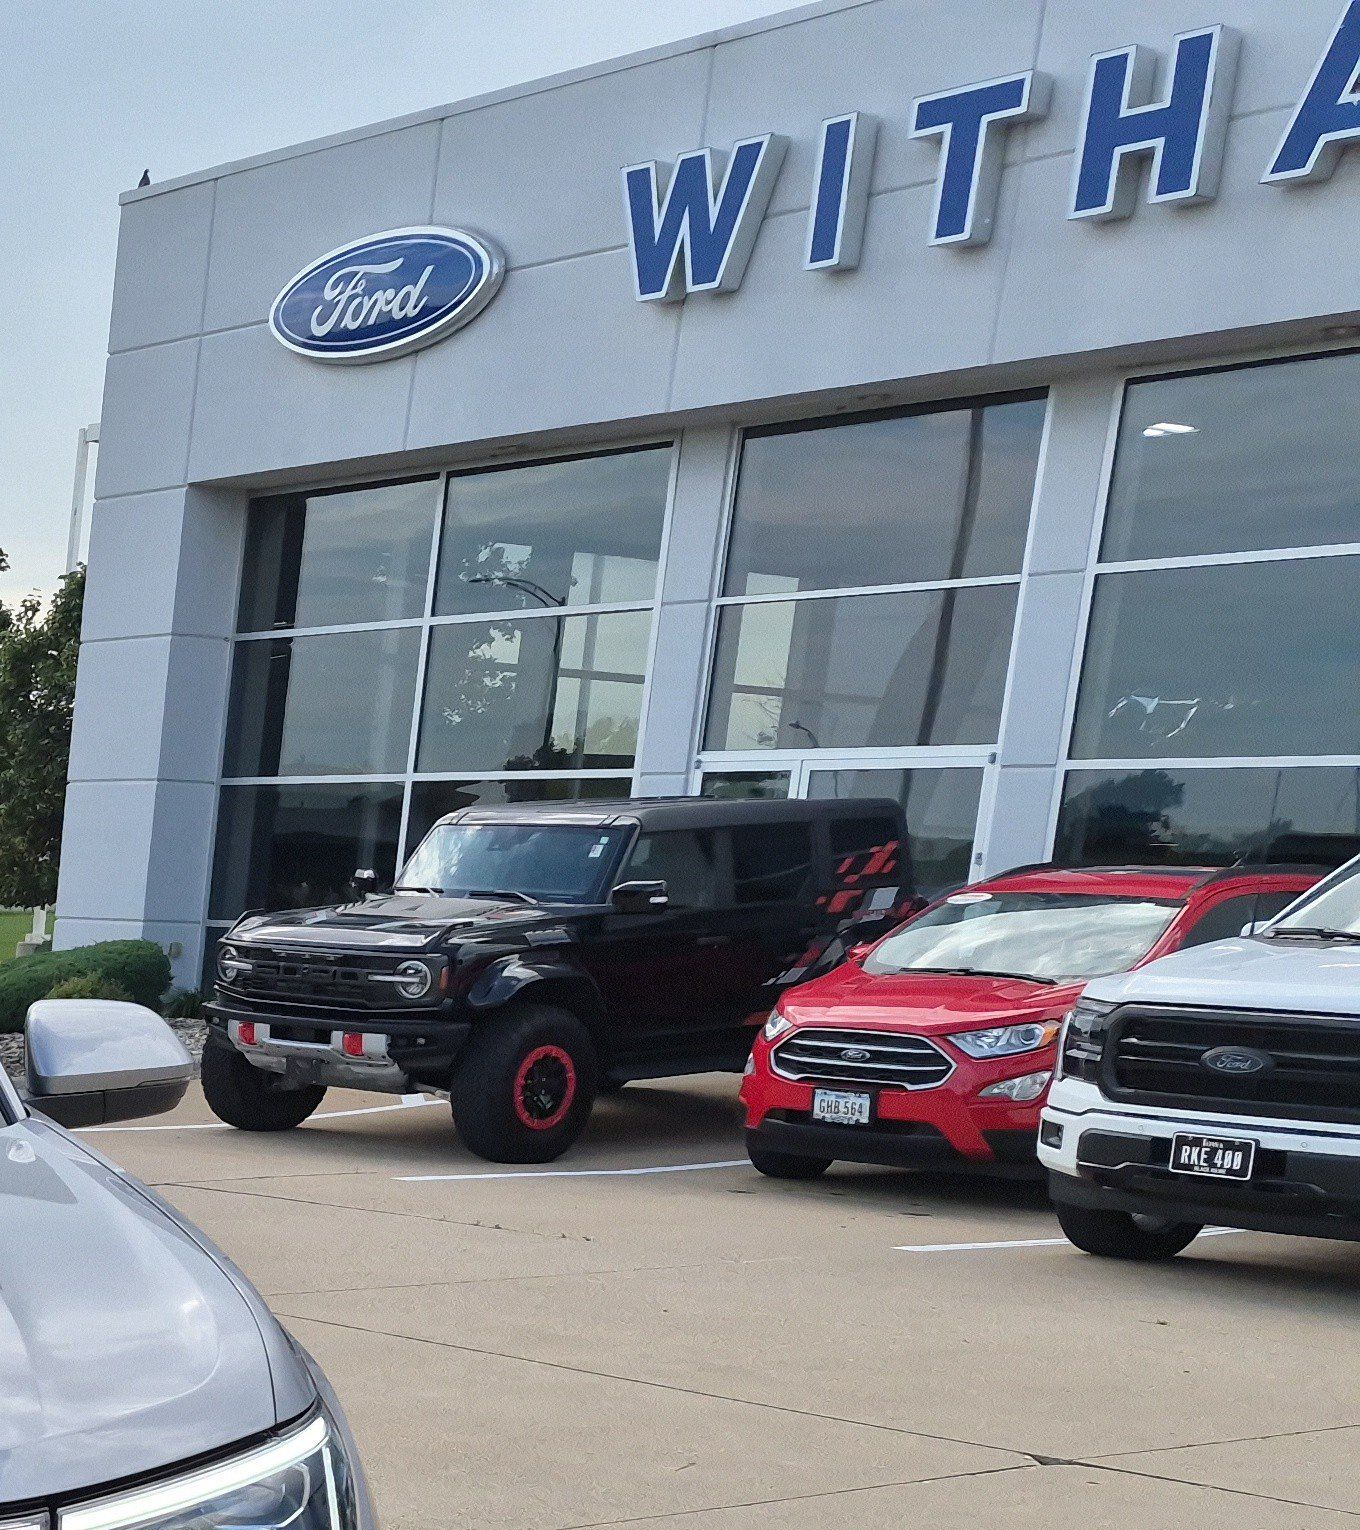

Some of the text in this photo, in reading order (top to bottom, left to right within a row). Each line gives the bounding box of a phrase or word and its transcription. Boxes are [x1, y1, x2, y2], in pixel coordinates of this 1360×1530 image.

[310, 257, 435, 337] Ford
[1216, 1054, 1252, 1070] Ford
[819, 1099, 863, 1117] GHB 564
[1180, 1145, 1210, 1167] RKE
[1214, 1149, 1243, 1170] 400
